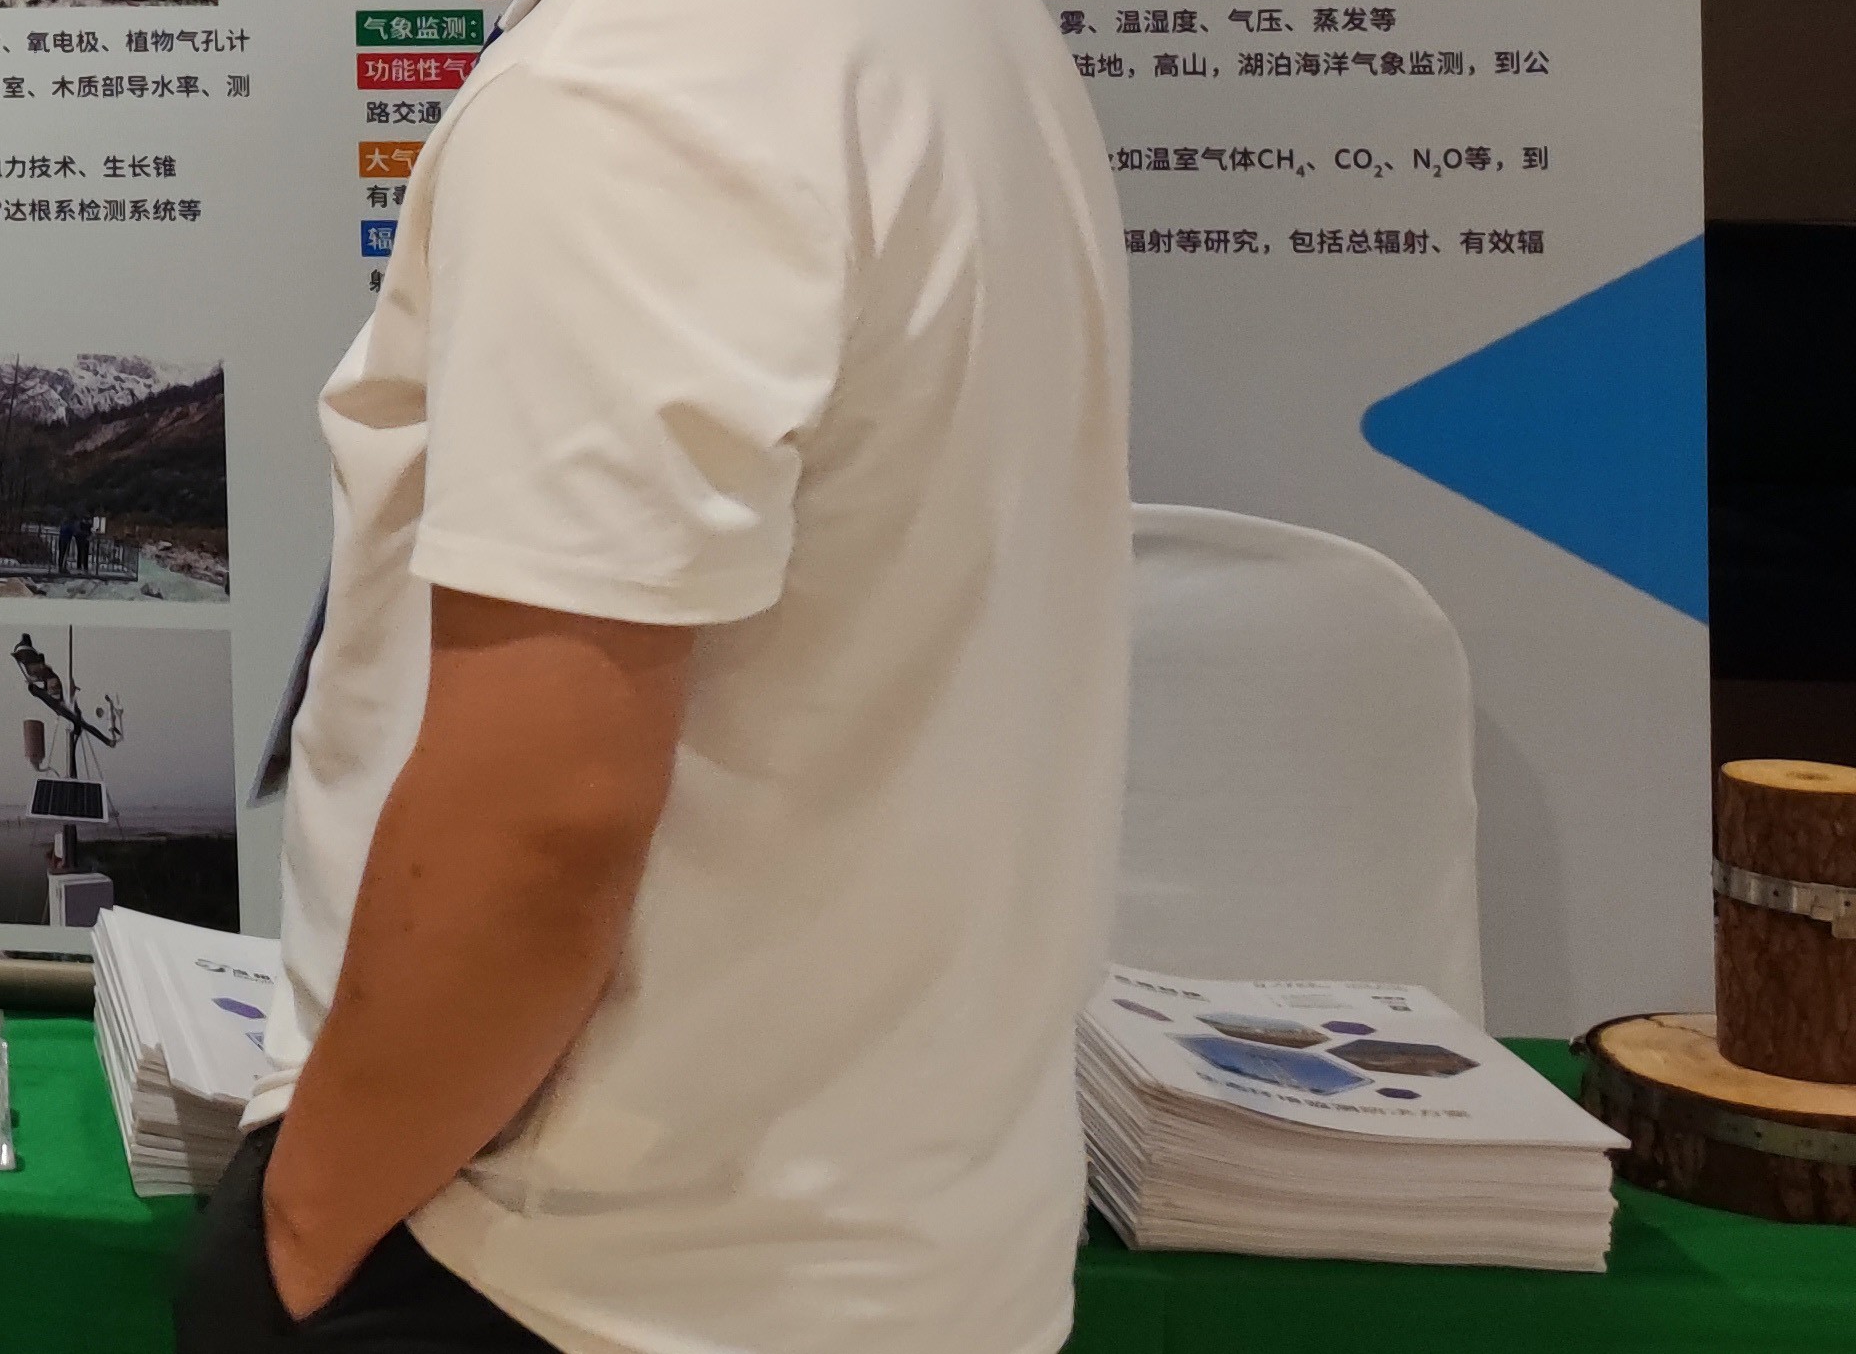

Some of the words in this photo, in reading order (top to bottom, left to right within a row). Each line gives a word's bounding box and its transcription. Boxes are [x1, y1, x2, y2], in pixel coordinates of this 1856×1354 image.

[364, 16, 477, 39] 气象监测：
[1059, 7, 1397, 35] 雾、温湿度、气压、蒸发等
[364, 58, 478, 82] 功能性气
[366, 101, 441, 124] 路交通
